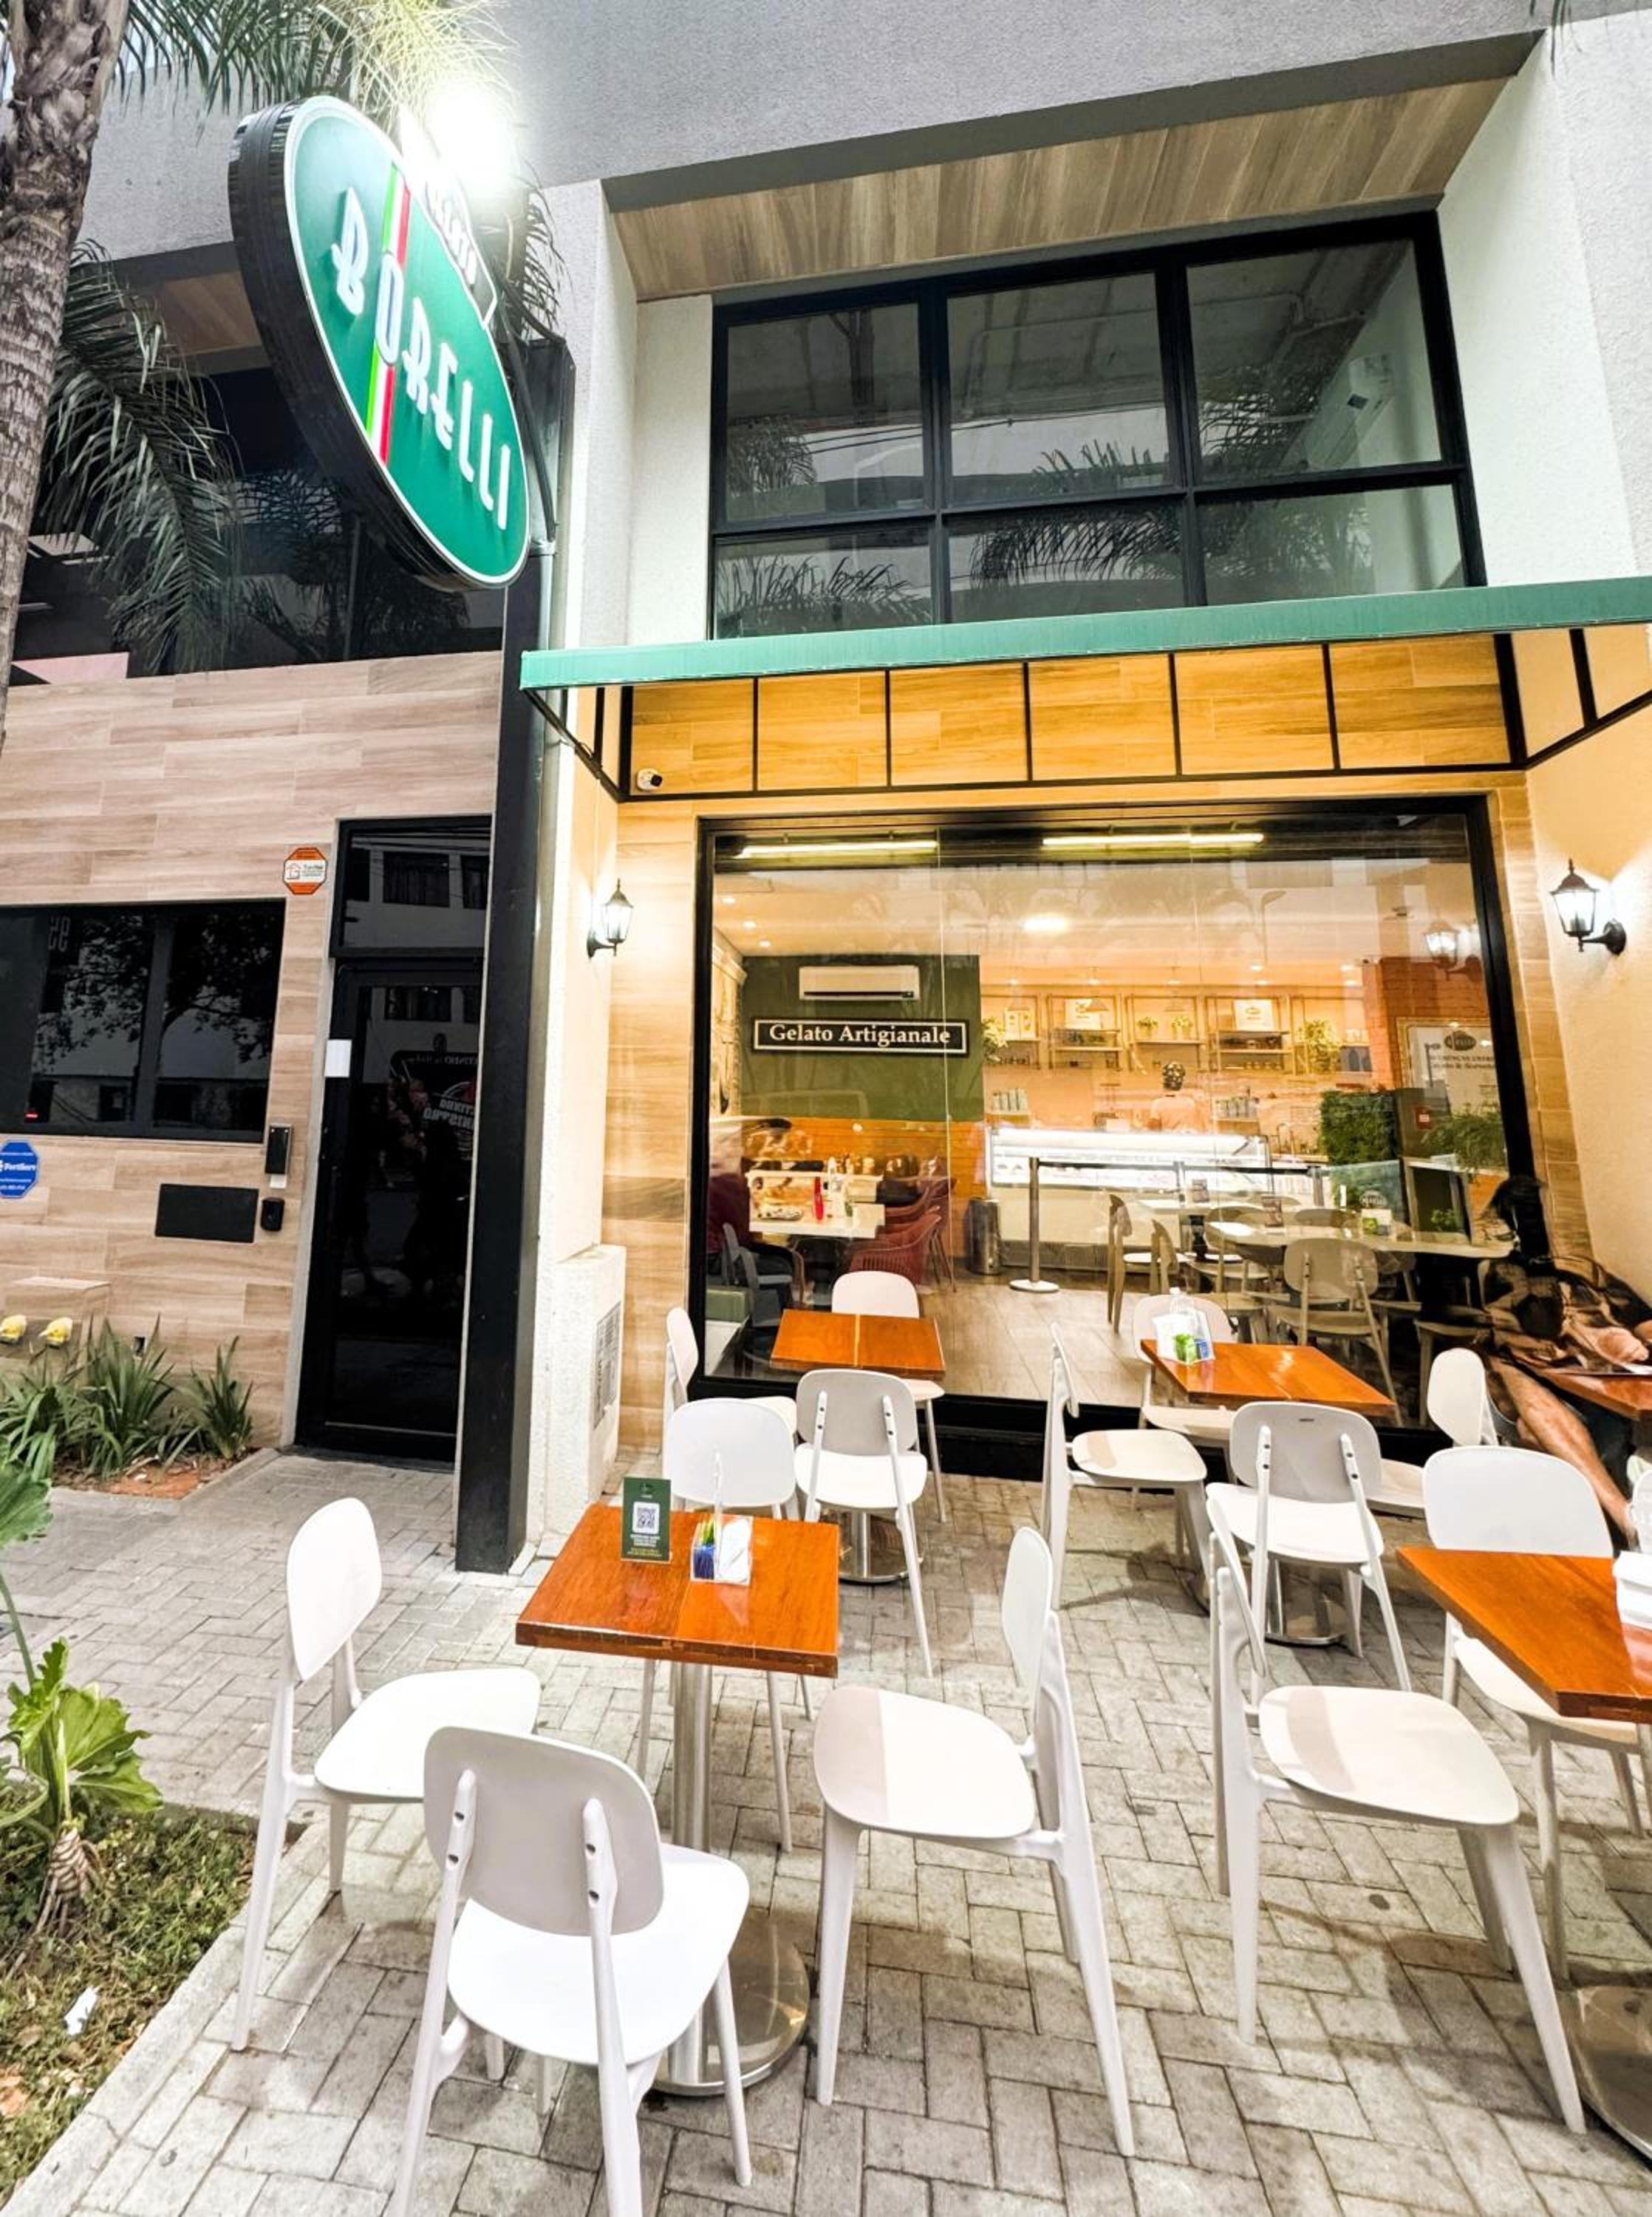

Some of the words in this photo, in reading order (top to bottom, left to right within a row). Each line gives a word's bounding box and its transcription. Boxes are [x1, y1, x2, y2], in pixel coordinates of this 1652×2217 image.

[330, 187, 511, 531] BORELLI
[769, 1024, 833, 1041] Gelato
[838, 1024, 951, 1047] Artigianale
